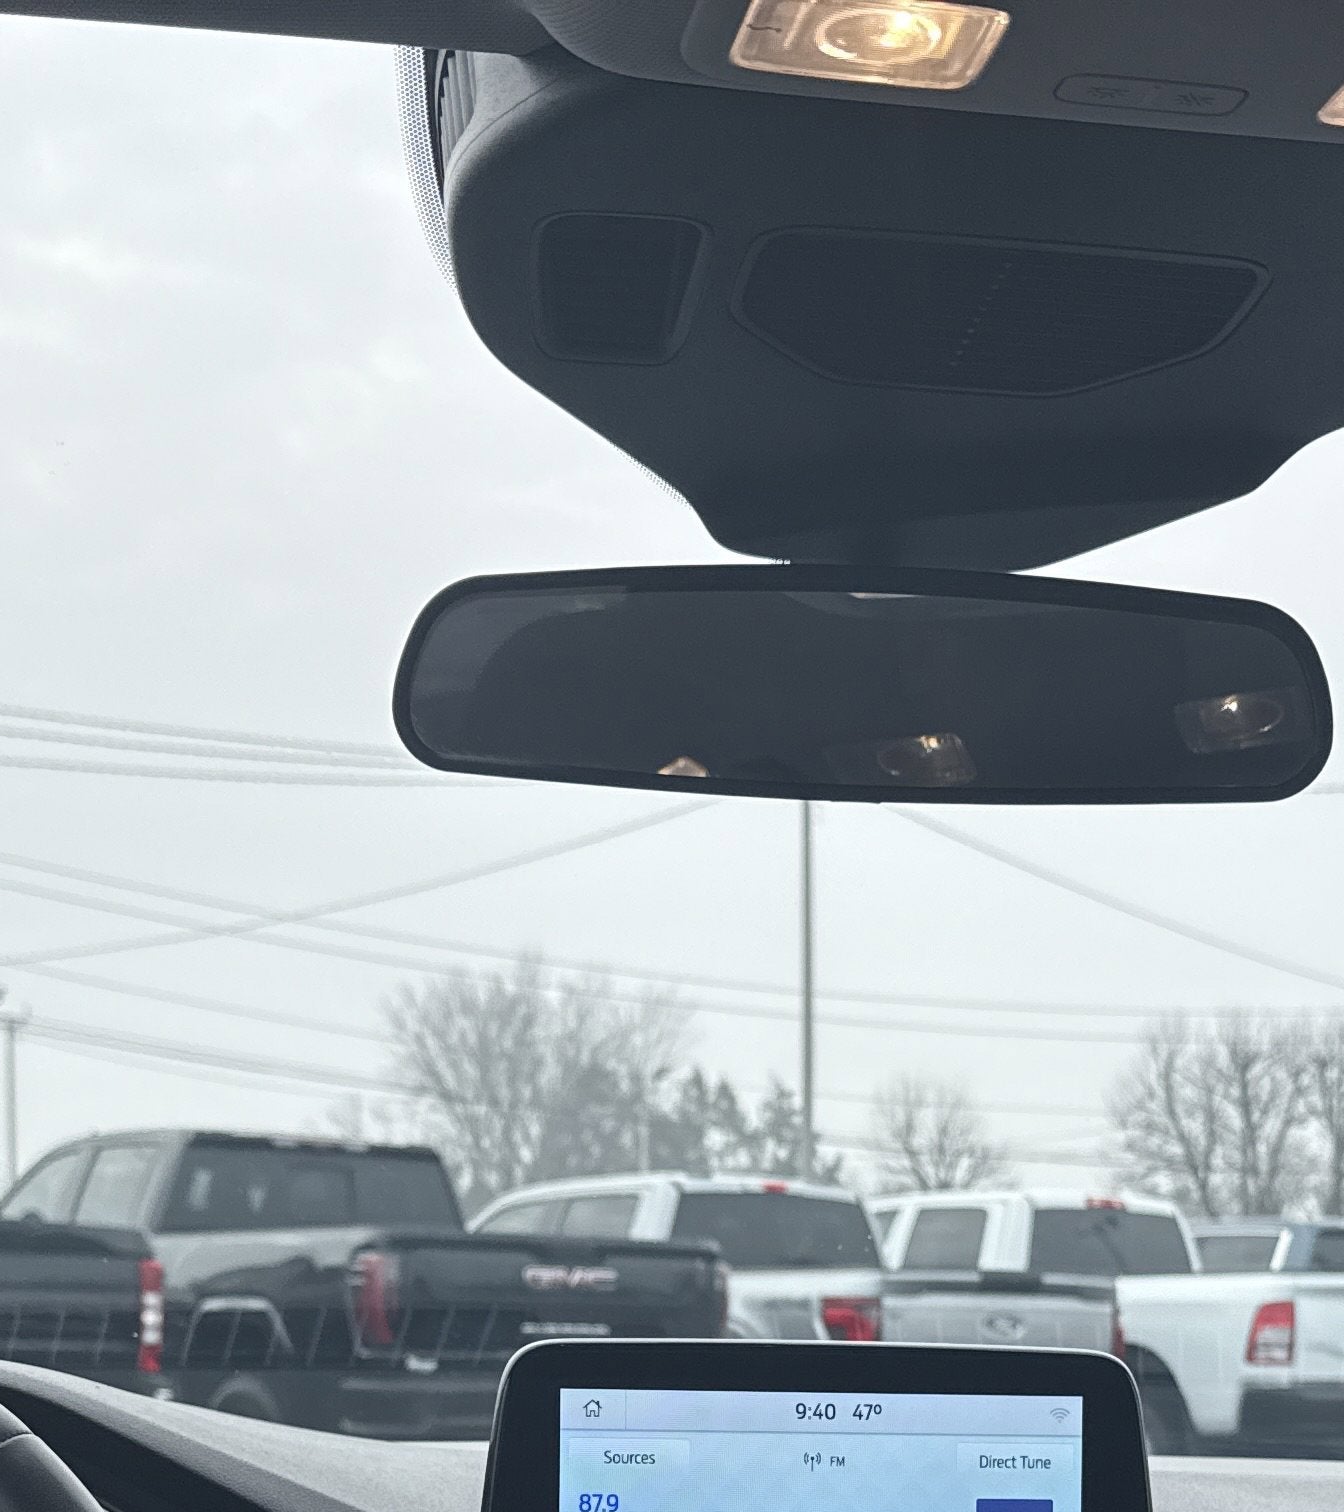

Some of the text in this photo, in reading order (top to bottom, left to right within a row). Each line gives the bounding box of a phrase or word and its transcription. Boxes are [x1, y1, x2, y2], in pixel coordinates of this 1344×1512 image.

[795, 1402, 836, 1420] 9:40
[603, 1450, 656, 1465] Sources
[829, 1456, 846, 1467] FM
[979, 1454, 1052, 1469] Direct Tune
[578, 1493, 619, 1512] 87.9
